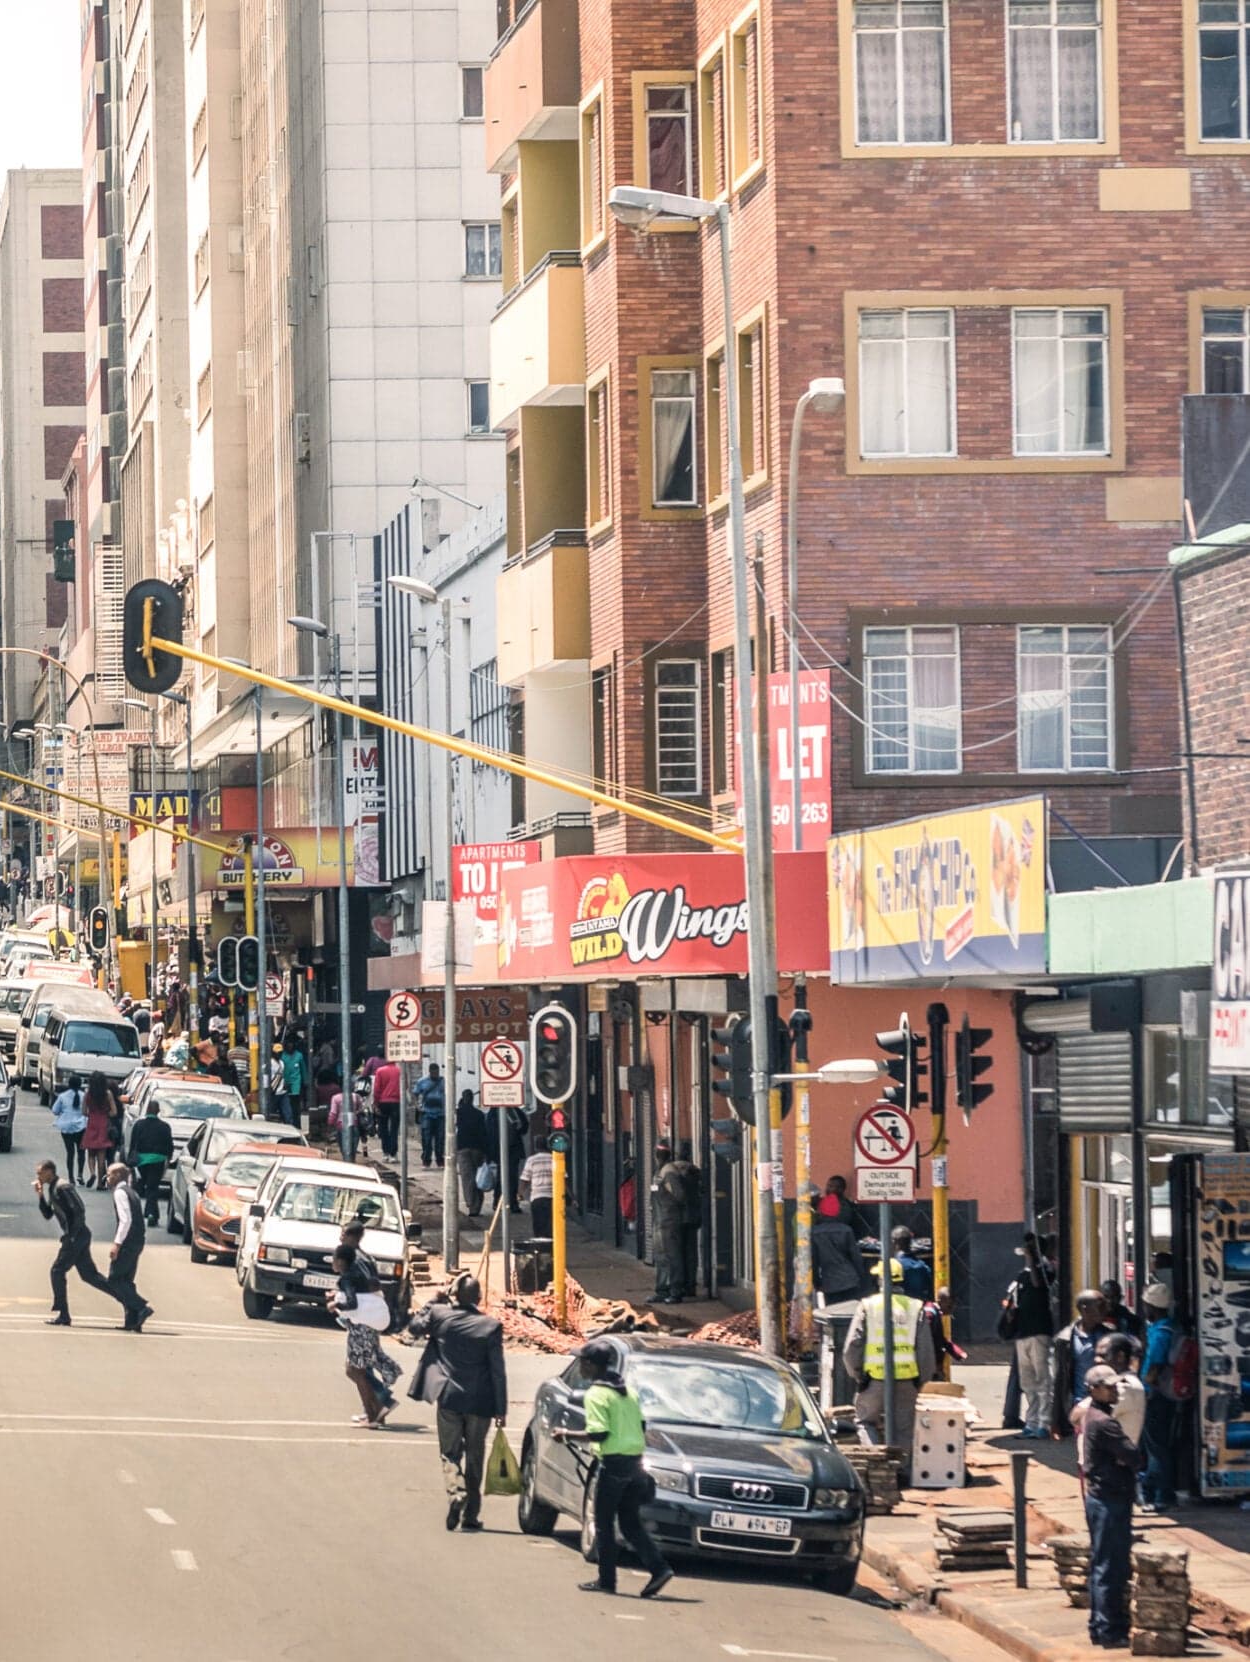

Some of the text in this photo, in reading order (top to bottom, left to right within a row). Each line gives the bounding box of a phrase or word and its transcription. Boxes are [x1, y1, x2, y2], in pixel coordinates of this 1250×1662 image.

[460, 844, 526, 860] APARTMENTS
[459, 862, 486, 894] TO
[618, 885, 750, 963] Wings
[571, 933, 623, 965] WILD
[469, 1022, 523, 1035] SPOT
